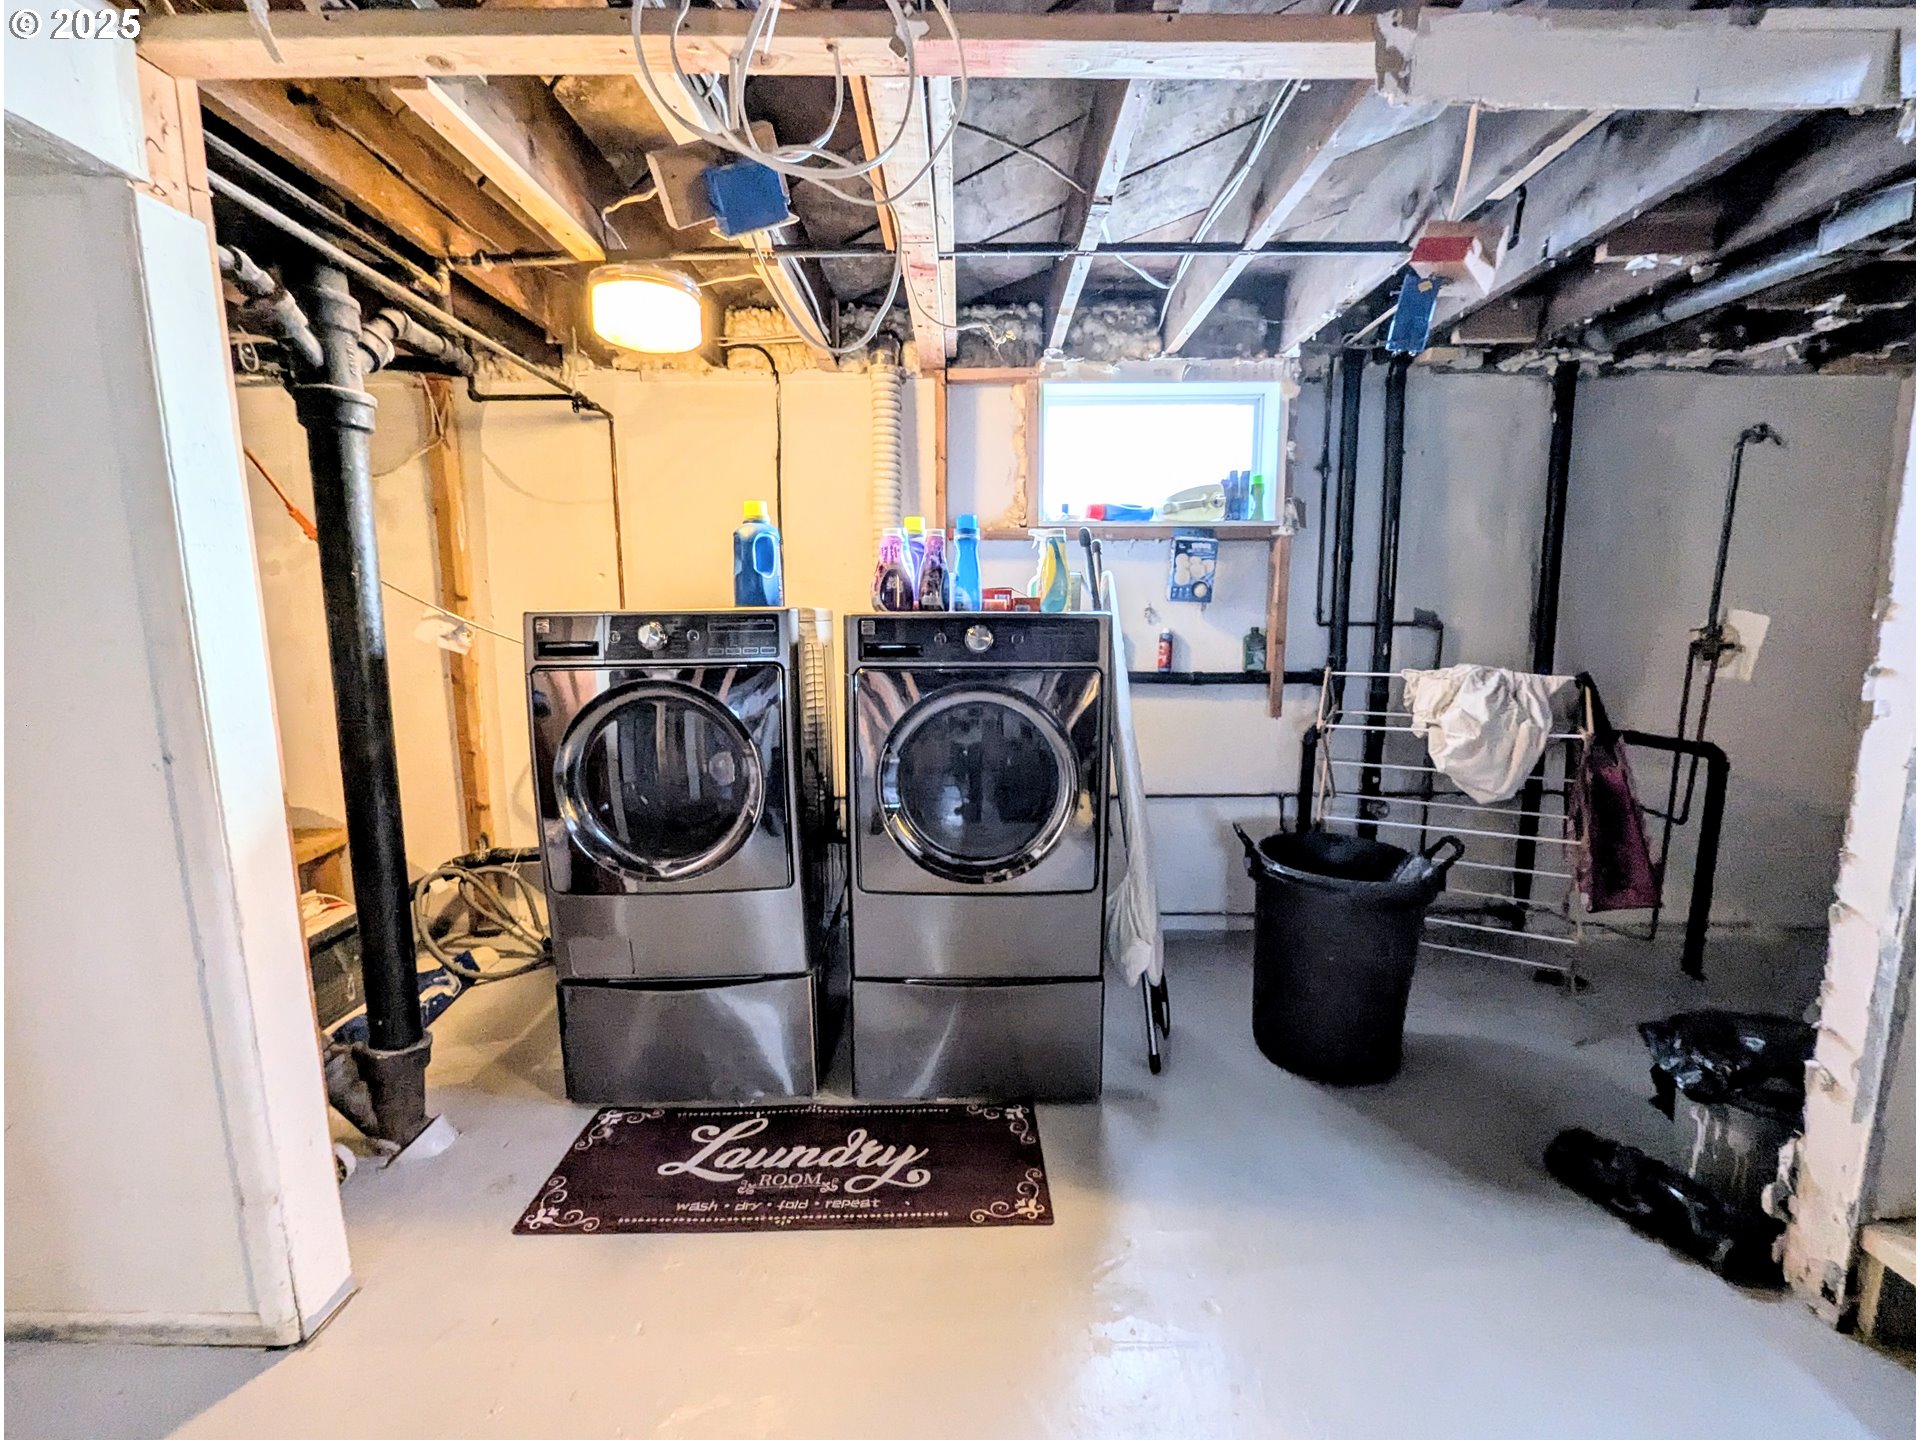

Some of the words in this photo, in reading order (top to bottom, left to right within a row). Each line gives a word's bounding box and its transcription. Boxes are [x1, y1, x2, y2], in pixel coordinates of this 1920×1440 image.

[657, 1118, 931, 1193] Laundry
[759, 1173, 822, 1186] ROOM
[676, 1200, 719, 1212] wash
[734, 1201, 763, 1211] dry
[777, 1199, 809, 1210] fold
[825, 1198, 881, 1209] repeat
